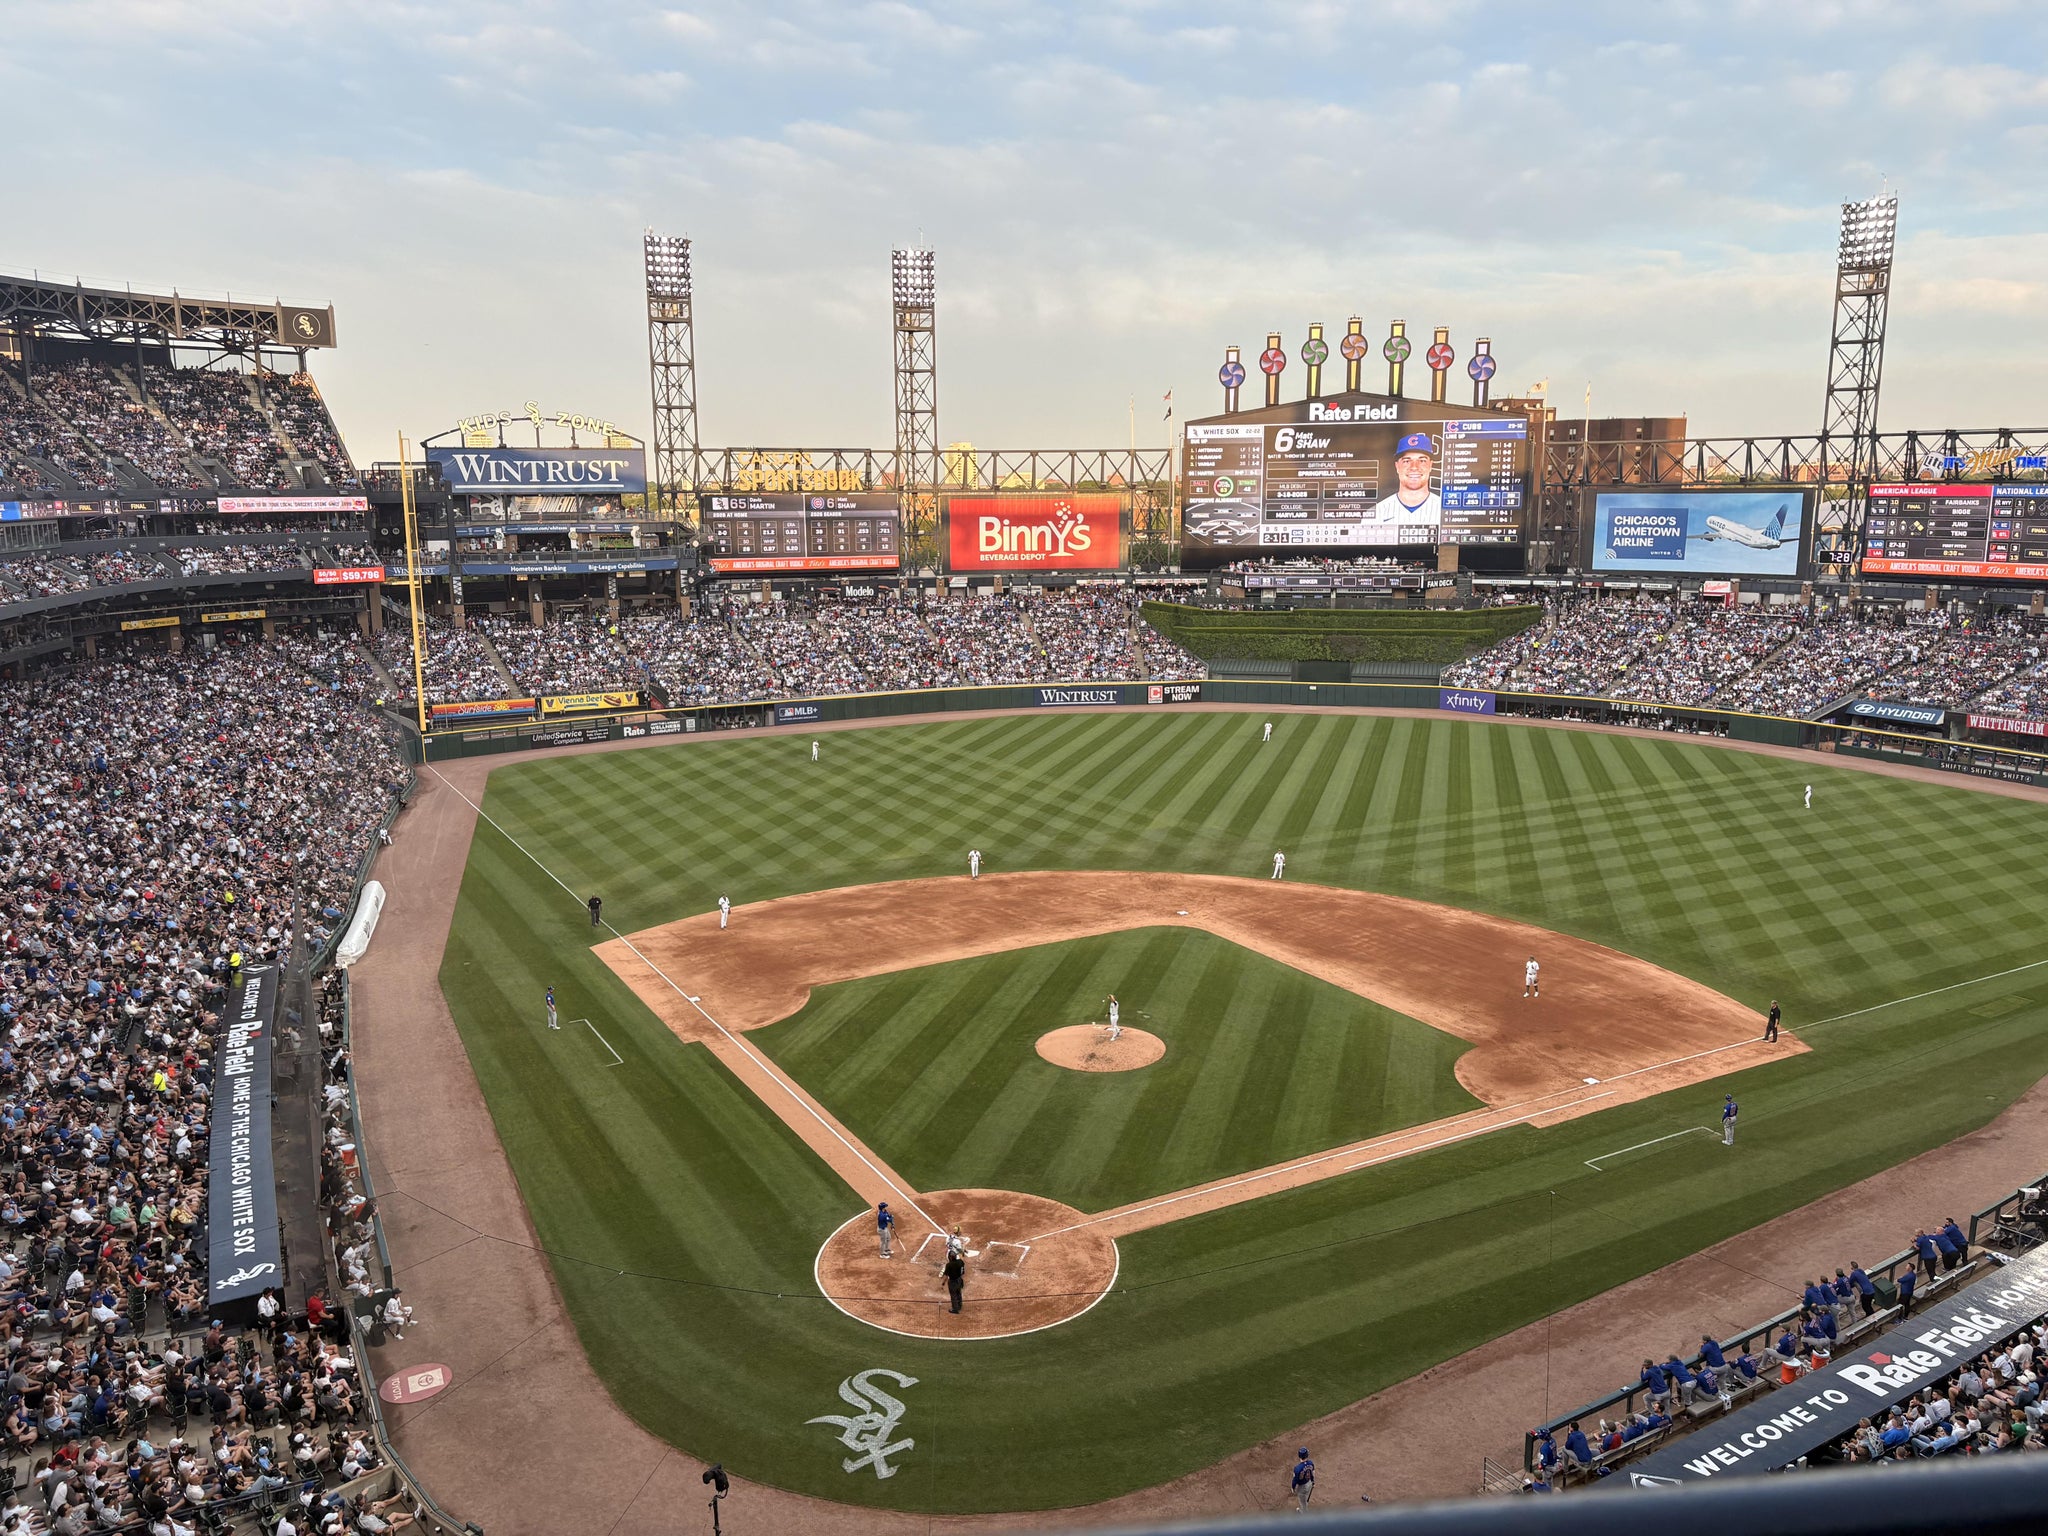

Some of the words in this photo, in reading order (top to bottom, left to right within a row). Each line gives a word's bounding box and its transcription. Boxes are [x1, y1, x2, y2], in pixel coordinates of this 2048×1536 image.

[1309, 402, 1351, 421] Rate
[1354, 404, 1398, 420] Field
[458, 411, 512, 434] KIDS
[556, 412, 615, 436] ZONE
[1274, 428, 1295, 452] 6
[1295, 432, 1313, 440] Matt
[1296, 439, 1331, 449] SHAW
[737, 452, 813, 466] CAESARS
[1923, 456, 1941, 469] Lite
[1963, 446, 2031, 475] Miller
[2015, 456, 2047, 469] TIME
[452, 454, 624, 482] WINTRUST
[739, 469, 863, 491] SPORTSBOOK
[1996, 487, 2033, 495] NATIONAL
[730, 498, 747, 509] 65
[827, 498, 835, 509] 6
[1614, 515, 1677, 526] CHICAGO'S
[1709, 519, 1726, 530] UNITED
[979, 513, 1092, 557] Binny's
[1613, 526, 1680, 537] HOMETOWN
[1282, 534, 1287, 542] 1
[1613, 537, 1654, 547] AIRLINE
[980, 553, 1020, 561] BEVERAGE
[1021, 553, 1046, 561] DEPOT
[1829, 552, 1850, 562] 7:28
[393, 566, 436, 575] WINRUST
[617, 562, 646, 570] Capabilities
[1865, 561, 1886, 570] Tito's
[1889, 562, 1916, 571] AMERICA'S
[1917, 563, 1941, 572] ORIGINAL
[1943, 564, 1960, 572] CRAFT
[1961, 564, 1980, 573] VODKA
[1987, 566, 2011, 574] Tito's
[2014, 566, 2044, 576] AMERICA'S
[342, 570, 380, 581] $59,796
[1222, 578, 1231, 586] FAN
[1231, 578, 1243, 587] DECK
[1427, 580, 1438, 588] FAN
[1439, 579, 1454, 587] DECK
[845, 585, 875, 597] Modelo
[1041, 689, 1118, 703] WINTRUST
[1164, 686, 1200, 695] STREAM
[557, 696, 585, 705] Vienna
[586, 694, 603, 702] Beef
[1171, 693, 1192, 701] NOW
[1447, 693, 1487, 711] xfinity
[458, 703, 492, 715] Surfside
[794, 706, 818, 716] MLB+
[1610, 702, 1633, 711] THE
[1876, 706, 1936, 722] HYUNDAI
[623, 725, 645, 737] Rate
[1969, 715, 2045, 735] WHITTINGHAM
[532, 730, 583, 742] UnitedService
[553, 737, 584, 746] Companies
[241, 977, 262, 1010] WELCOME
[240, 1009, 257, 1020] TO
[226, 1020, 263, 1049] Rate
[224, 1046, 255, 1076] Field
[232, 1076, 250, 1103] HOME
[232, 1103, 250, 1116] OF
[231, 1119, 250, 1137] THE
[231, 1137, 251, 1185] CHICAGO
[231, 1186, 254, 1227] WHITE
[233, 1228, 256, 1257] SOX
[391, 1377, 403, 1401] TOYOTA
[1683, 1405, 1818, 1477] WELCOME
[1806, 1389, 1849, 1412] TO
[1836, 1350, 1942, 1397] Rate
[1915, 1306, 2012, 1358] Field
